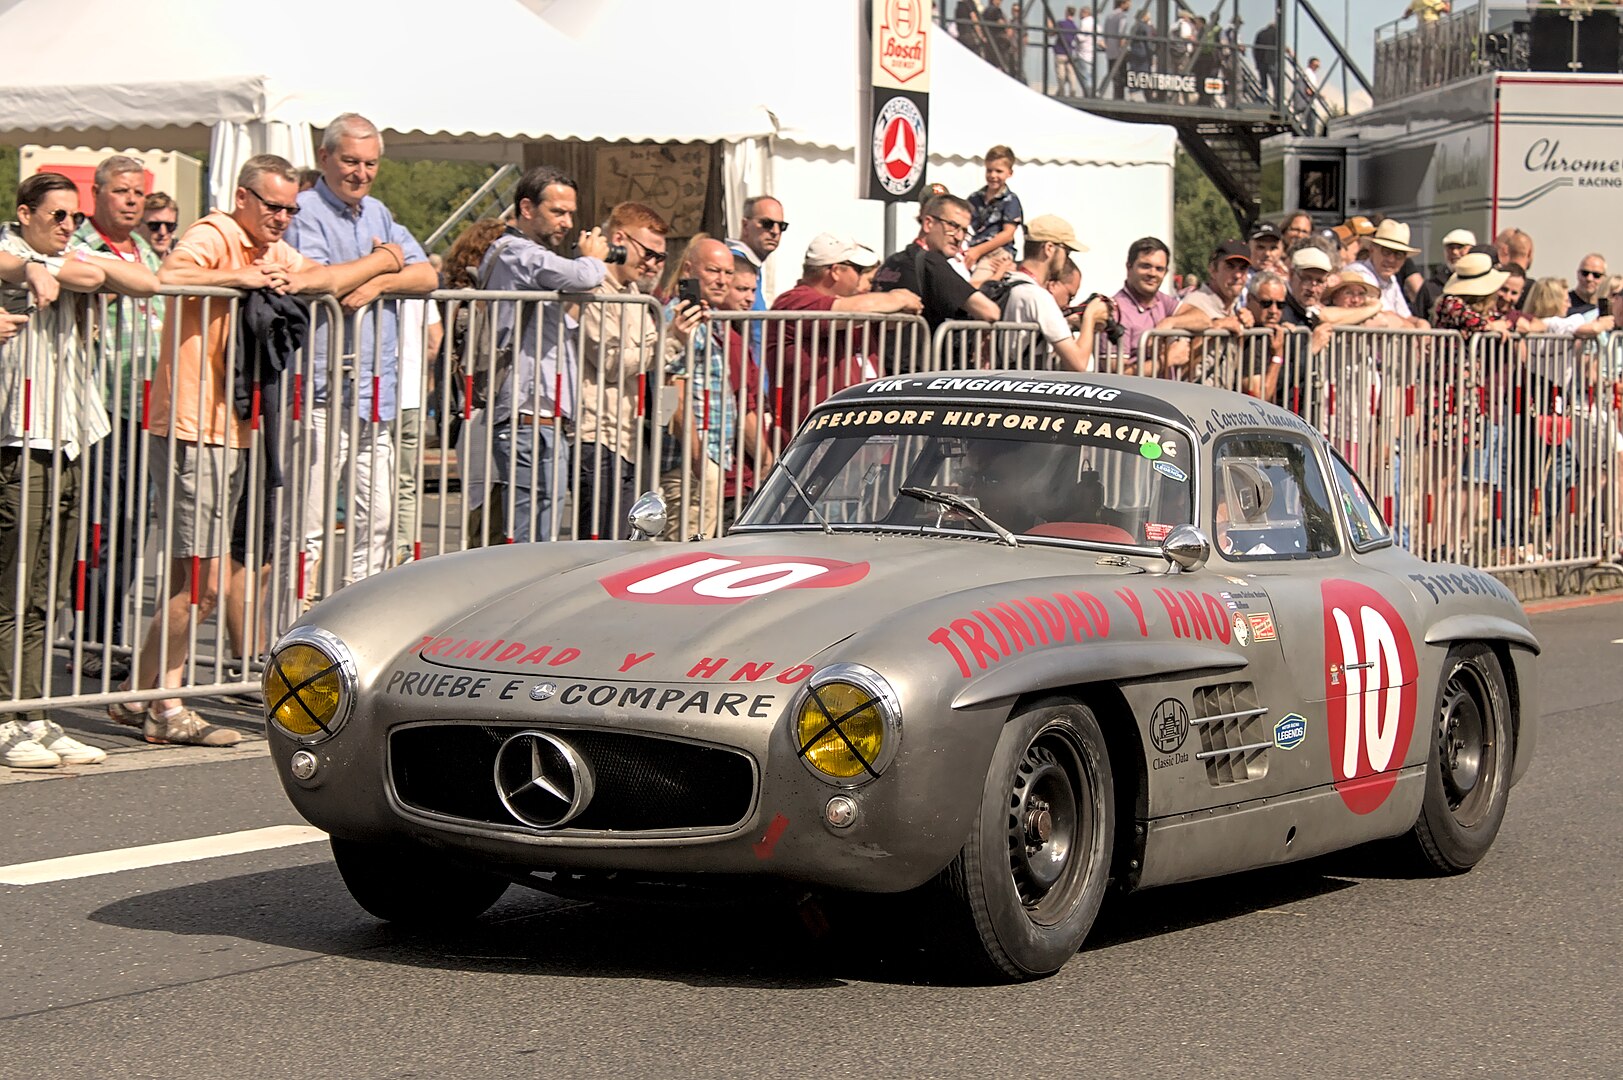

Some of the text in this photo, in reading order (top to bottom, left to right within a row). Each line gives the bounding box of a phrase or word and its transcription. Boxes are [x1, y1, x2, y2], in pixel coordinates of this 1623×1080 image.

[884, 37, 921, 60] Bosch
[1127, 71, 1197, 92] EVENTBRIDGE
[1524, 137, 1623, 172] Chrome
[1578, 176, 1623, 188] RACING
[867, 379, 912, 393] HK
[927, 378, 1121, 401] ENGINEERING
[1211, 408, 1259, 430] Carrera
[804, 410, 1178, 458] PFESSDORF HISTORIC RACING
[626, 557, 829, 598] 10
[928, 589, 1110, 679] TRINIDAD
[1114, 586, 1148, 638] Y
[1153, 587, 1231, 645] HNO
[409, 635, 815, 684] TRINIDAD Y HNO
[386, 670, 491, 698] PRUEBE
[499, 680, 524, 700] E
[560, 684, 775, 718] COMPARE
[1332, 605, 1403, 779] 10
[1277, 727, 1303, 742] LEGENDS
[1153, 753, 1189, 770] Classic Data
